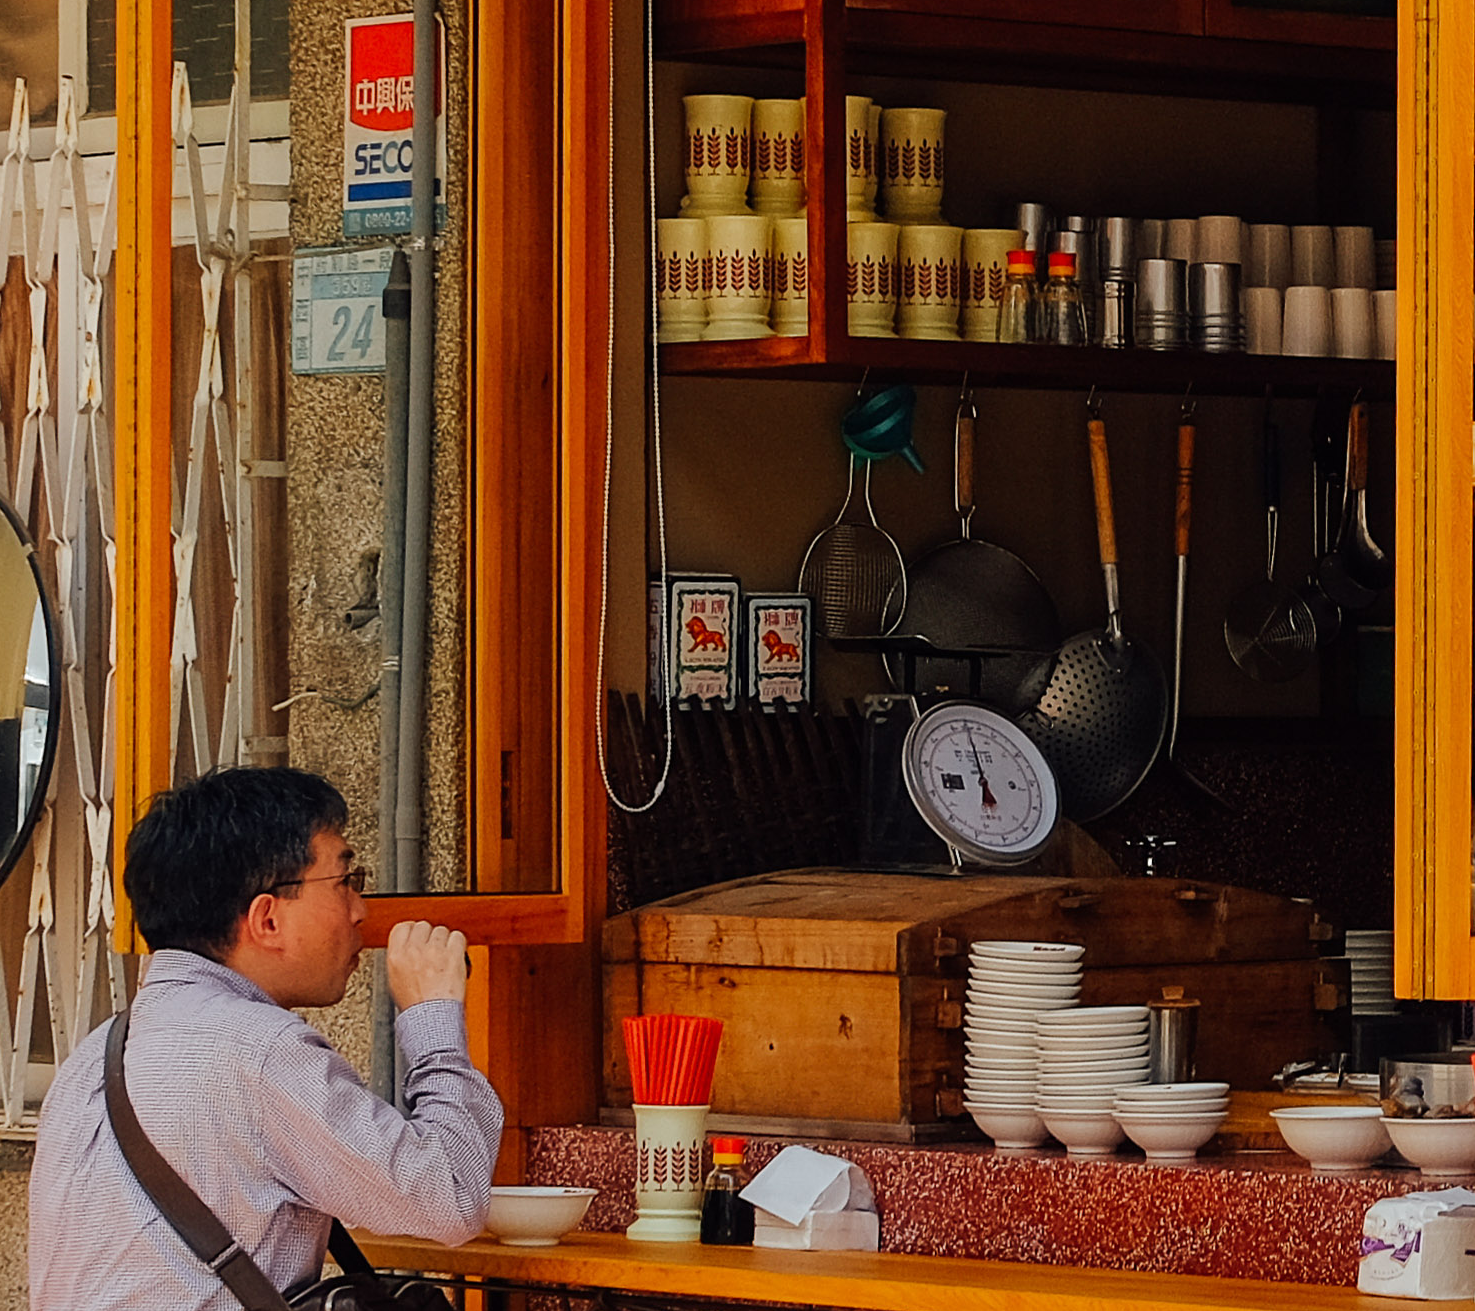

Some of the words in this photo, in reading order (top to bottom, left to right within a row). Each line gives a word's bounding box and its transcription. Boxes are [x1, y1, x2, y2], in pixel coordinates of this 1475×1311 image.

[355, 75, 414, 116] 中興保
[354, 140, 414, 176] SECO
[327, 304, 376, 362] 24
